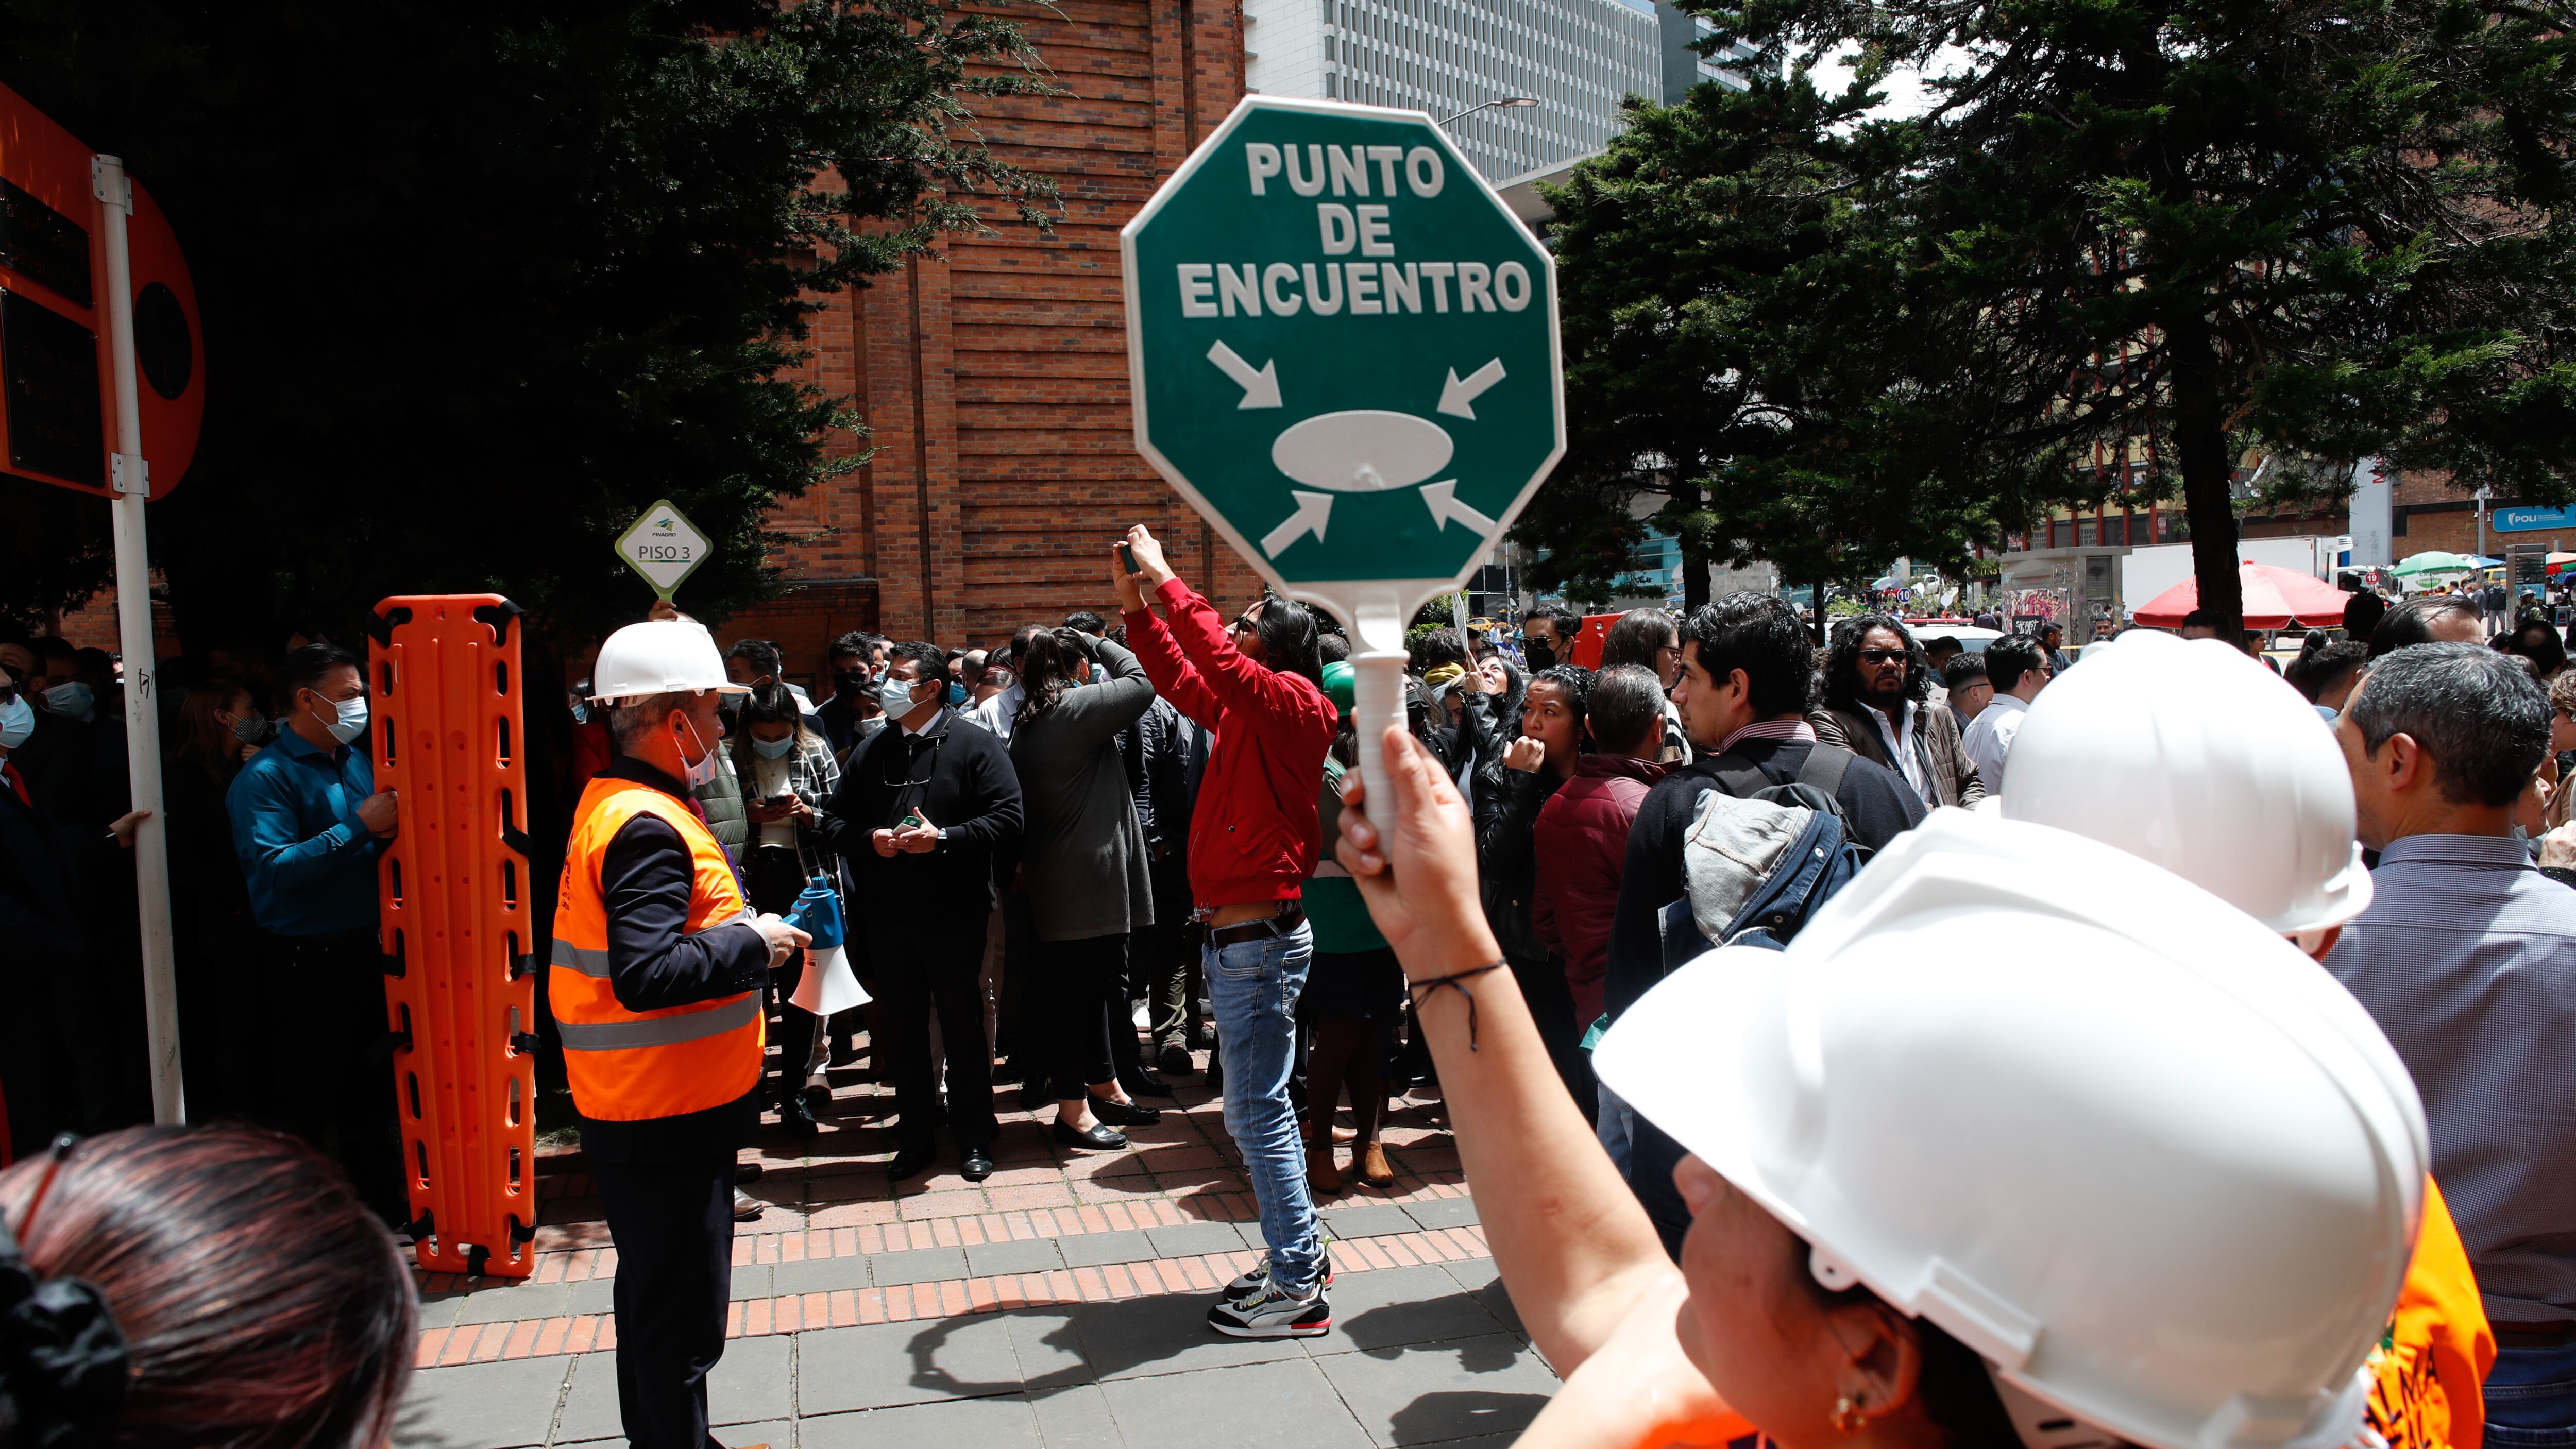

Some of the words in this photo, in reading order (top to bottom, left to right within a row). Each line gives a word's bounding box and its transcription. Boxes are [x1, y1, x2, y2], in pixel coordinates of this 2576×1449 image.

[1246, 143, 1444, 198] PUNTO
[1317, 203, 1395, 257] DE
[1177, 261, 1532, 317] ENCUENTRO
[639, 546, 676, 559] PISO
[682, 547, 690, 559] 3
[1899, 591, 1910, 600] 10
